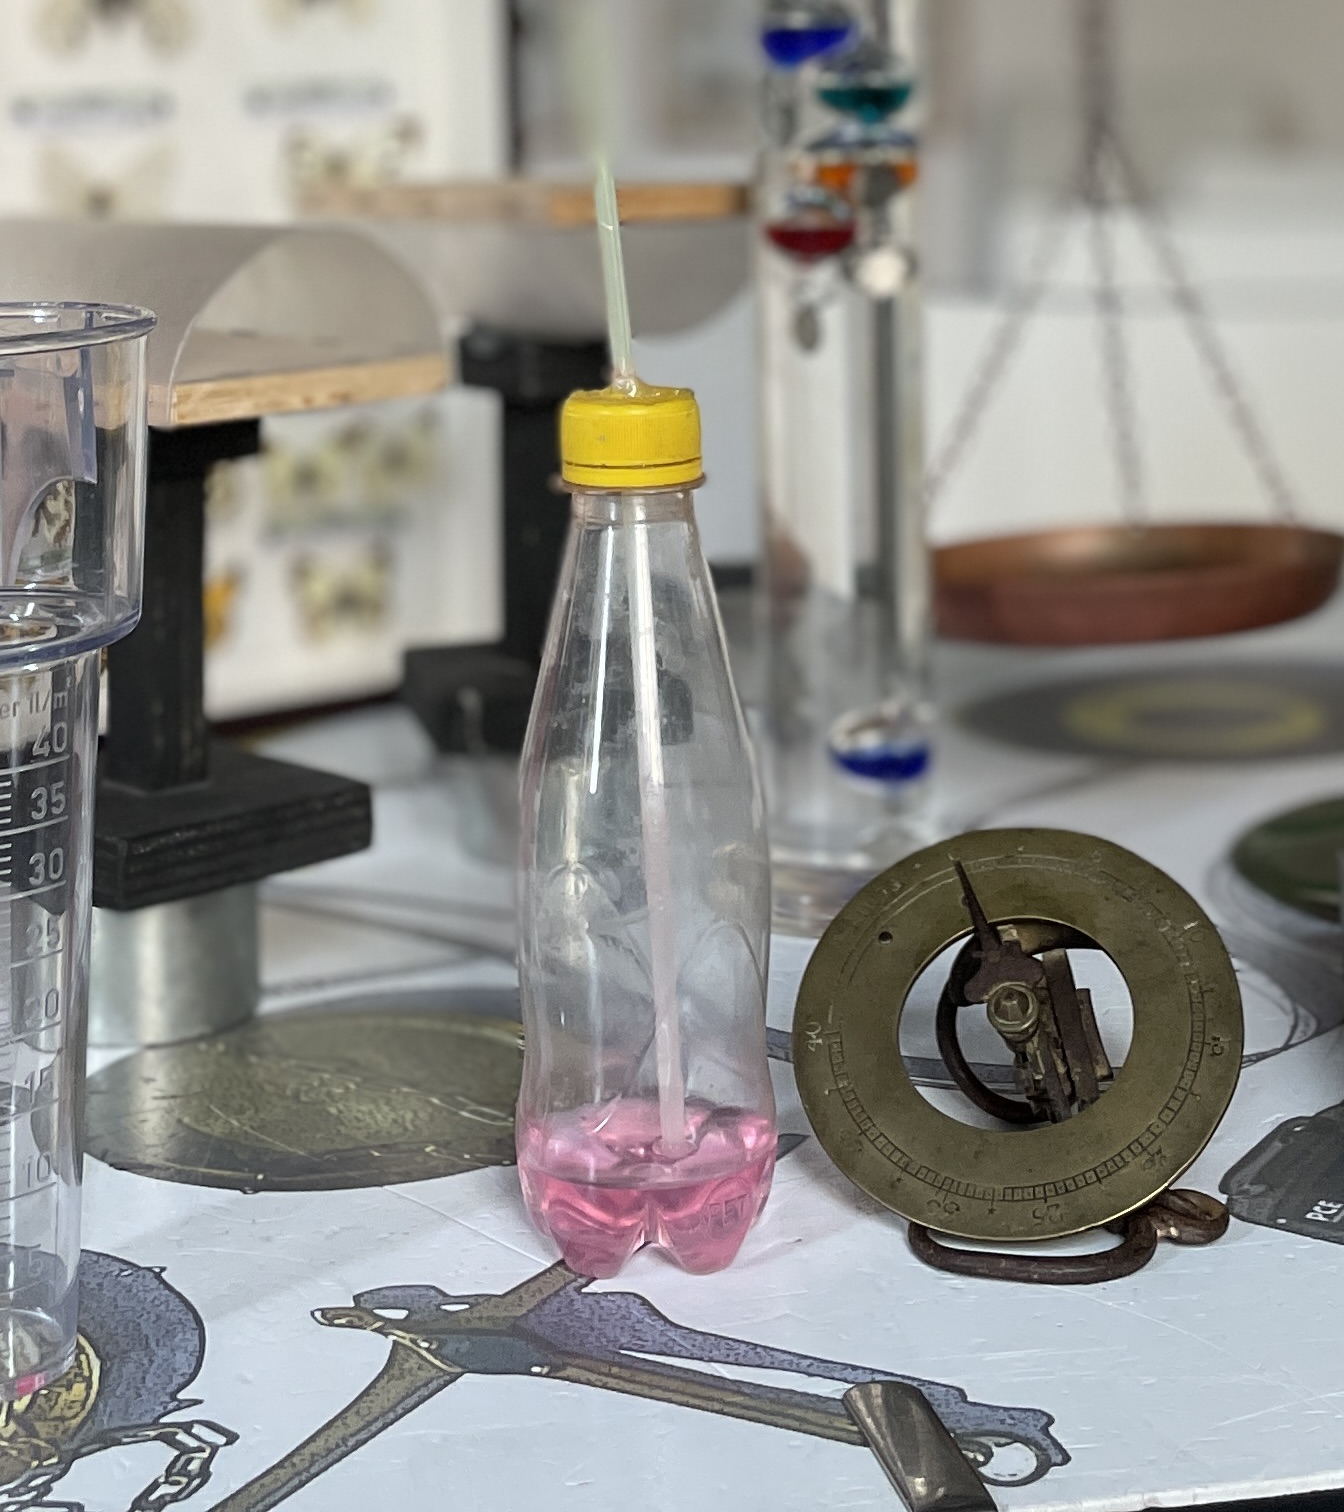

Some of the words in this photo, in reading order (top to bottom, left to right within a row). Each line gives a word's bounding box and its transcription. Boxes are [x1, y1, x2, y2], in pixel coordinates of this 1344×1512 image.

[32, 721, 68, 758] 40
[30, 782, 67, 821] 35
[28, 847, 65, 886] 30
[21, 1153, 52, 1189] 10
